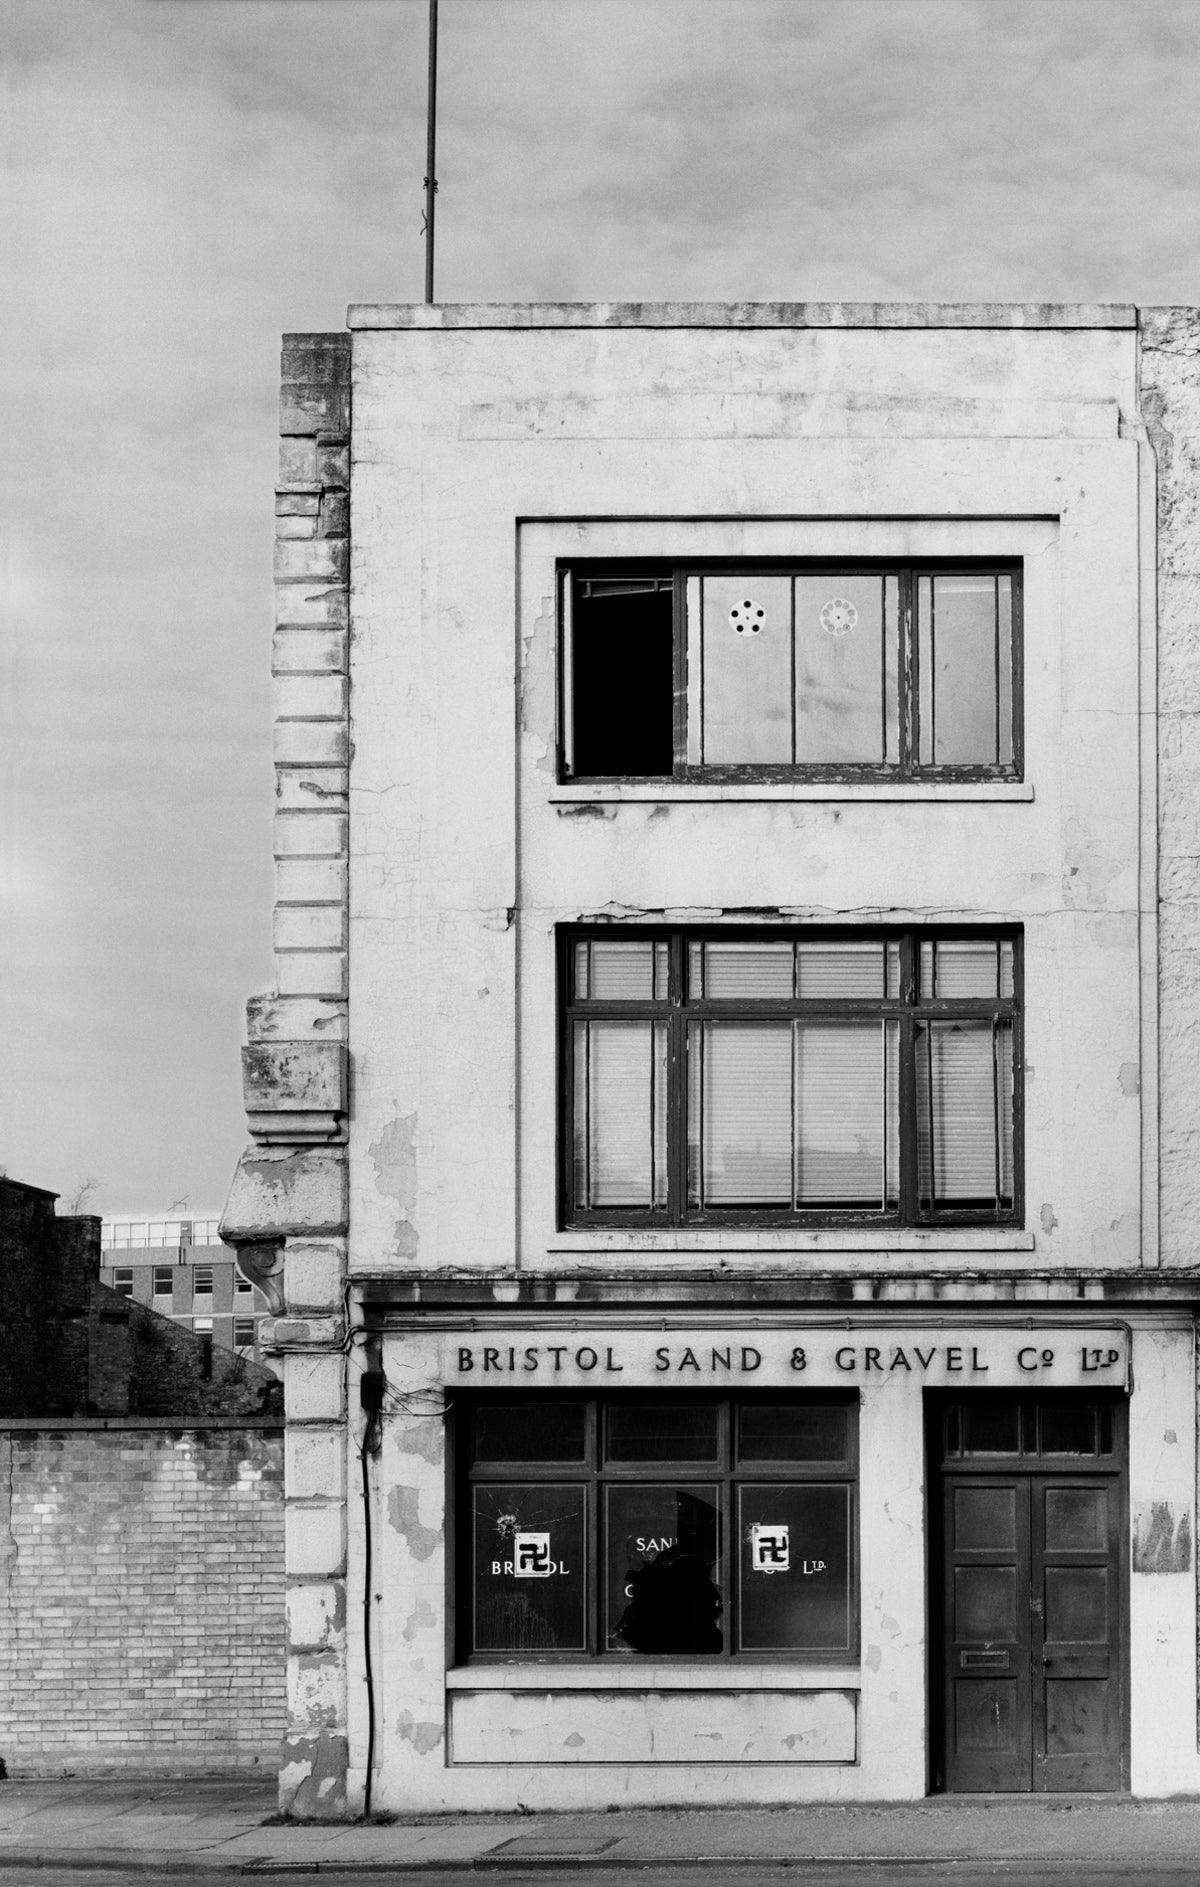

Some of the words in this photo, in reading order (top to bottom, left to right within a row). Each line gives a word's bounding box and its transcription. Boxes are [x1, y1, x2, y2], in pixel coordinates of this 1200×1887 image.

[457, 1347, 624, 1372] BRISTOL
[655, 1347, 762, 1372] SAND
[789, 1347, 807, 1372] &
[834, 1347, 989, 1372] GRAVEL
[636, 1537, 679, 1552] SAN
